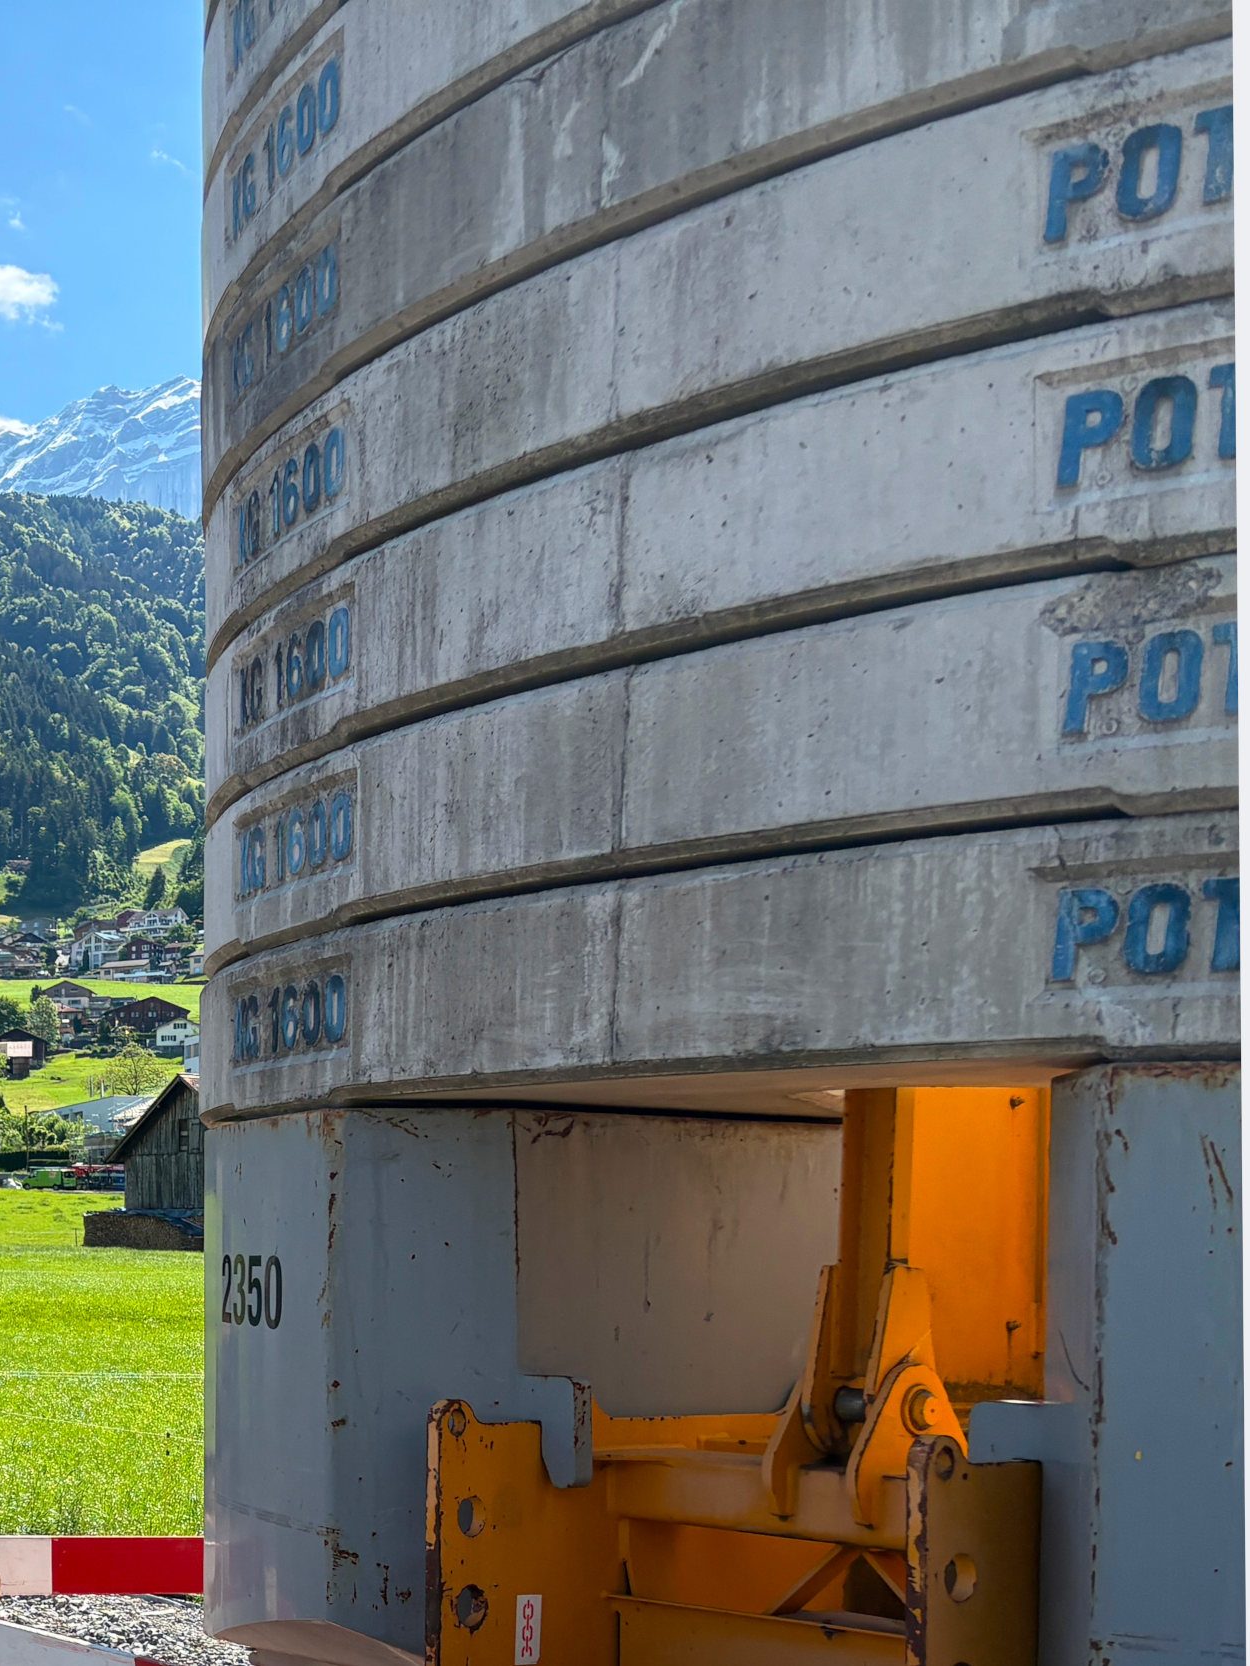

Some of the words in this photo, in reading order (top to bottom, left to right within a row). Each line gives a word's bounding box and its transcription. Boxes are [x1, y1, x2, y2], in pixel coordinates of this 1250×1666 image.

[263, 58, 339, 194] 1600
[1043, 104, 1234, 243] POT
[263, 241, 338, 370] 1600
[268, 426, 345, 535] 1600
[275, 605, 349, 705] 1600
[275, 790, 352, 881] 1600
[1051, 876, 1240, 982] POT
[269, 974, 347, 1054] 1600
[221, 1253, 283, 1330] 2350
